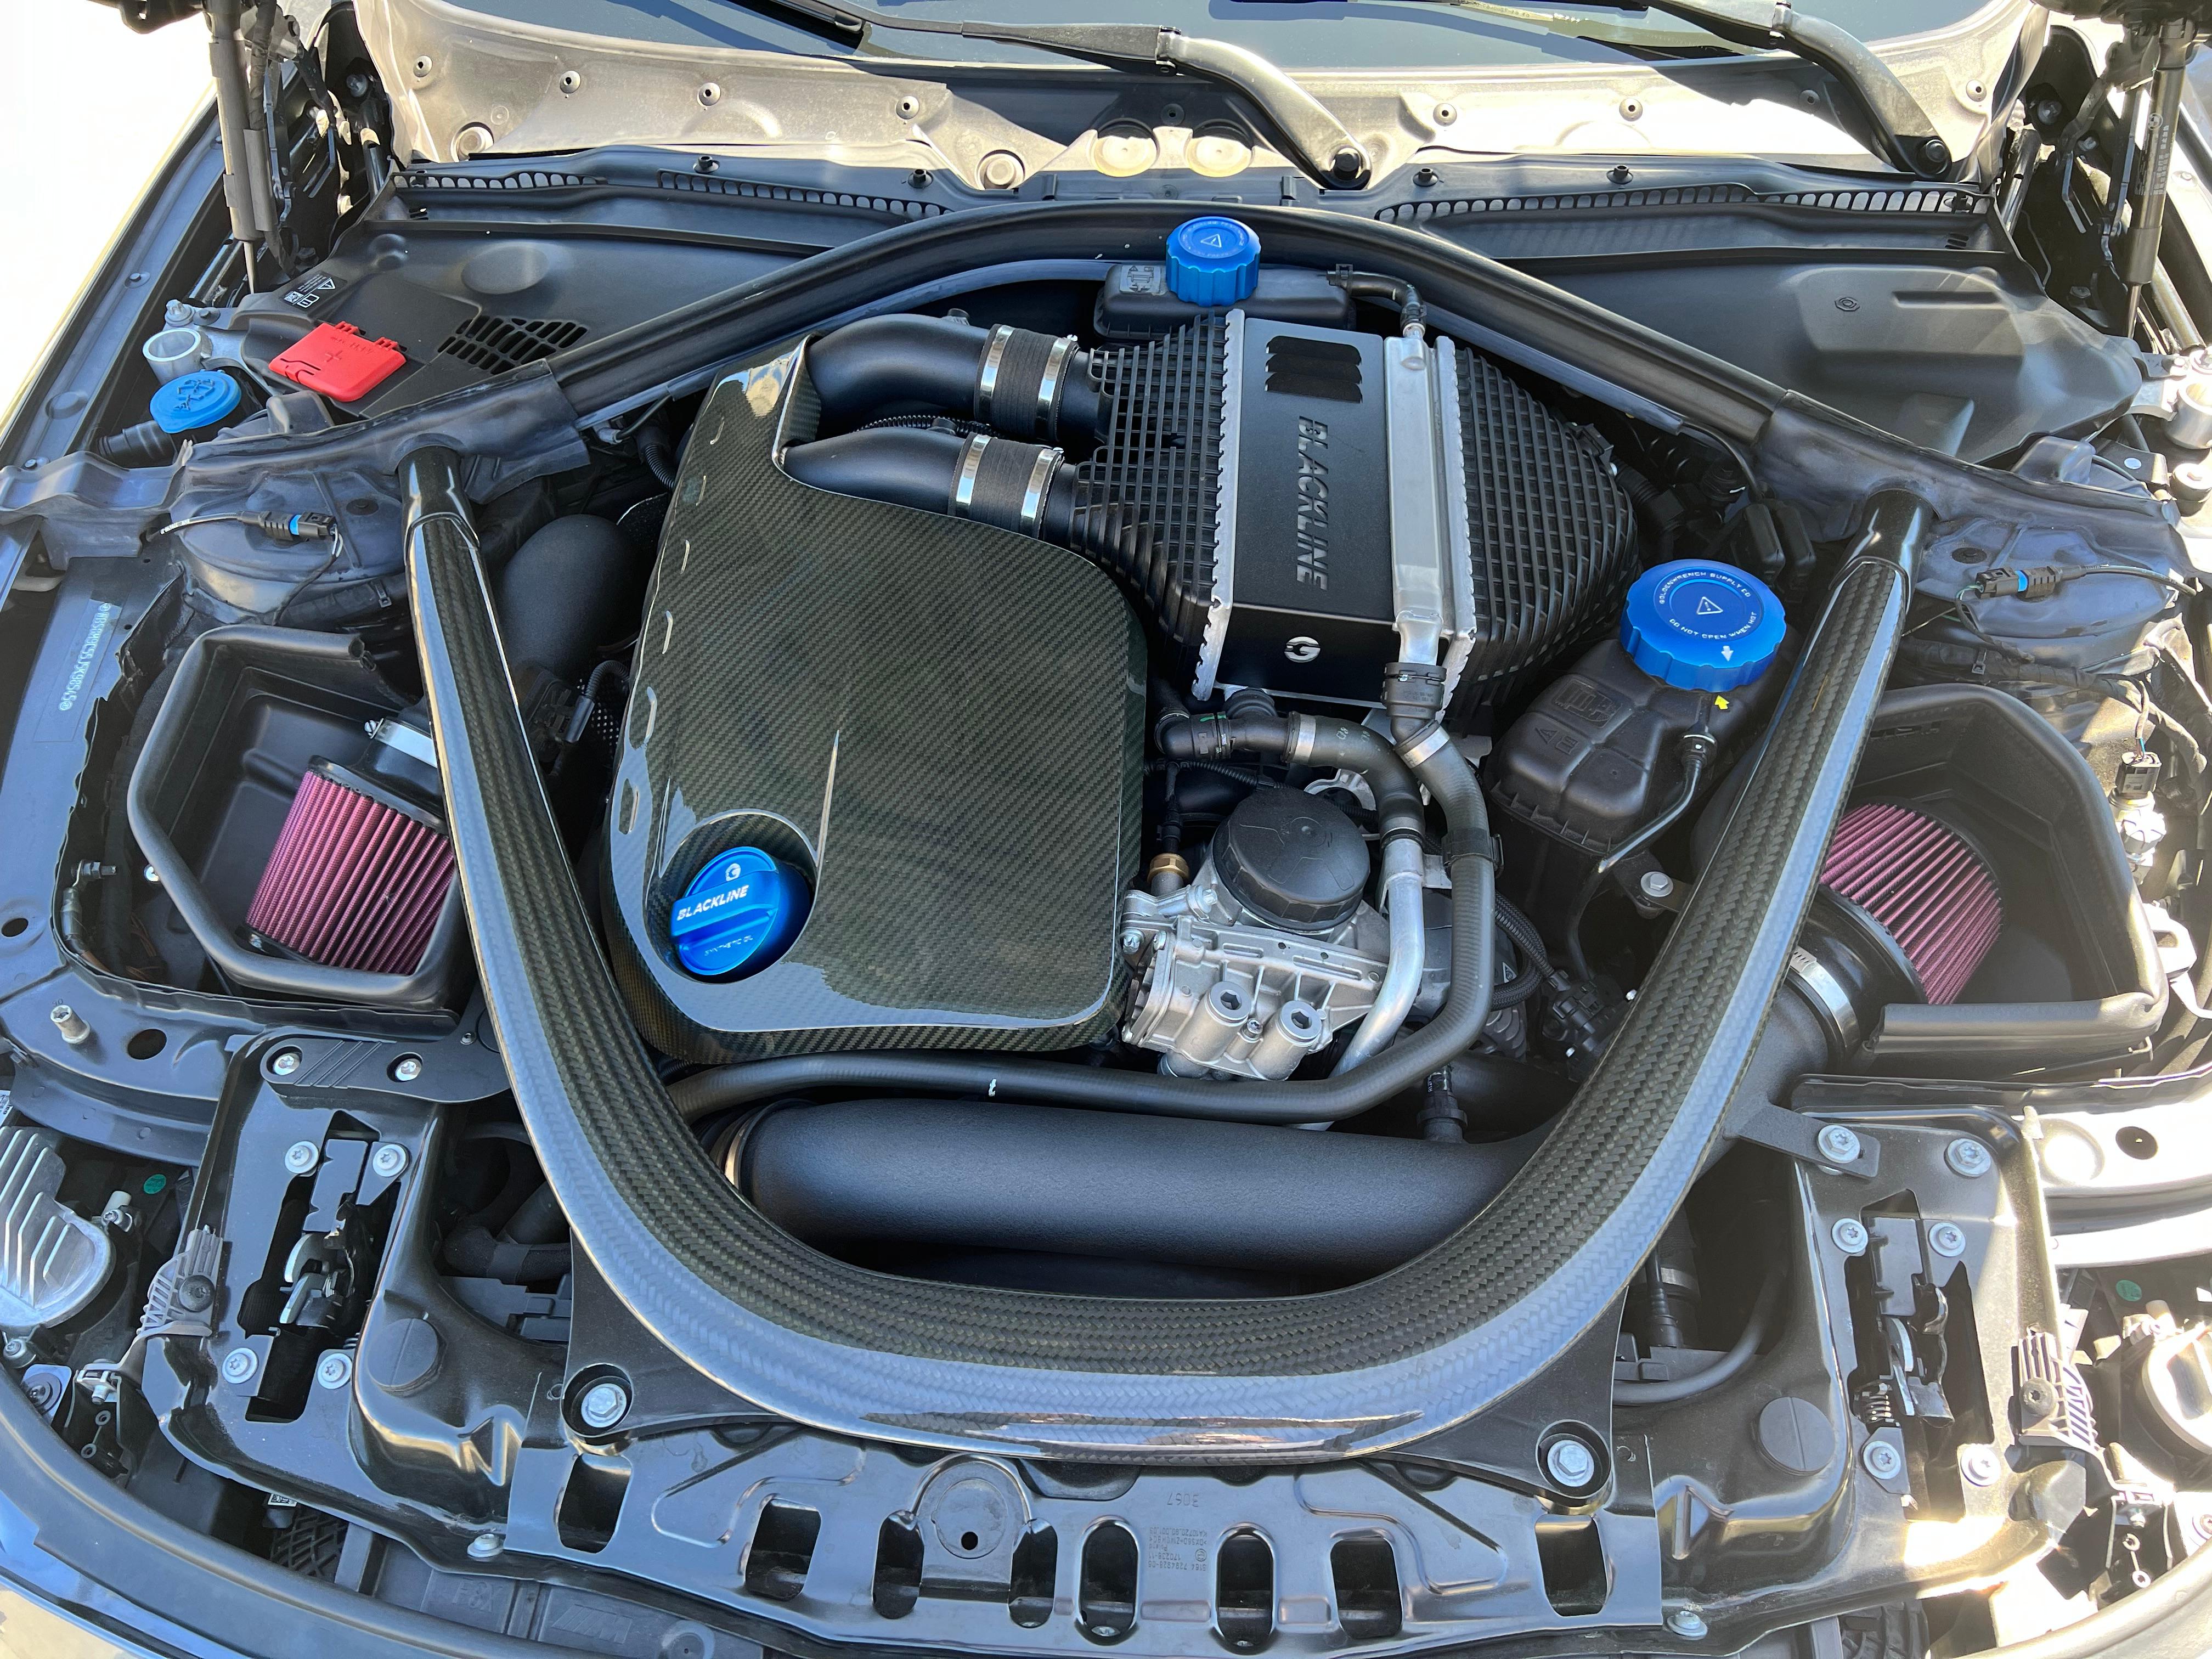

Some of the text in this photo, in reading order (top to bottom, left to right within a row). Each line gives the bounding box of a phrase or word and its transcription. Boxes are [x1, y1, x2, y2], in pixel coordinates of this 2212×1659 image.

[1296, 415, 1329, 591] BLACKLINE
[1658, 571, 1752, 605] GOLDENWRENCH SUPPLY CO
[1669, 618, 1680, 629] DO
[1680, 625, 1699, 637] NOT
[1728, 622, 1752, 639] WHEN
[1748, 611, 1758, 626] HOT
[676, 884, 749, 922] BLACKLINE
[1166, 1492, 1199, 1508] 3067
